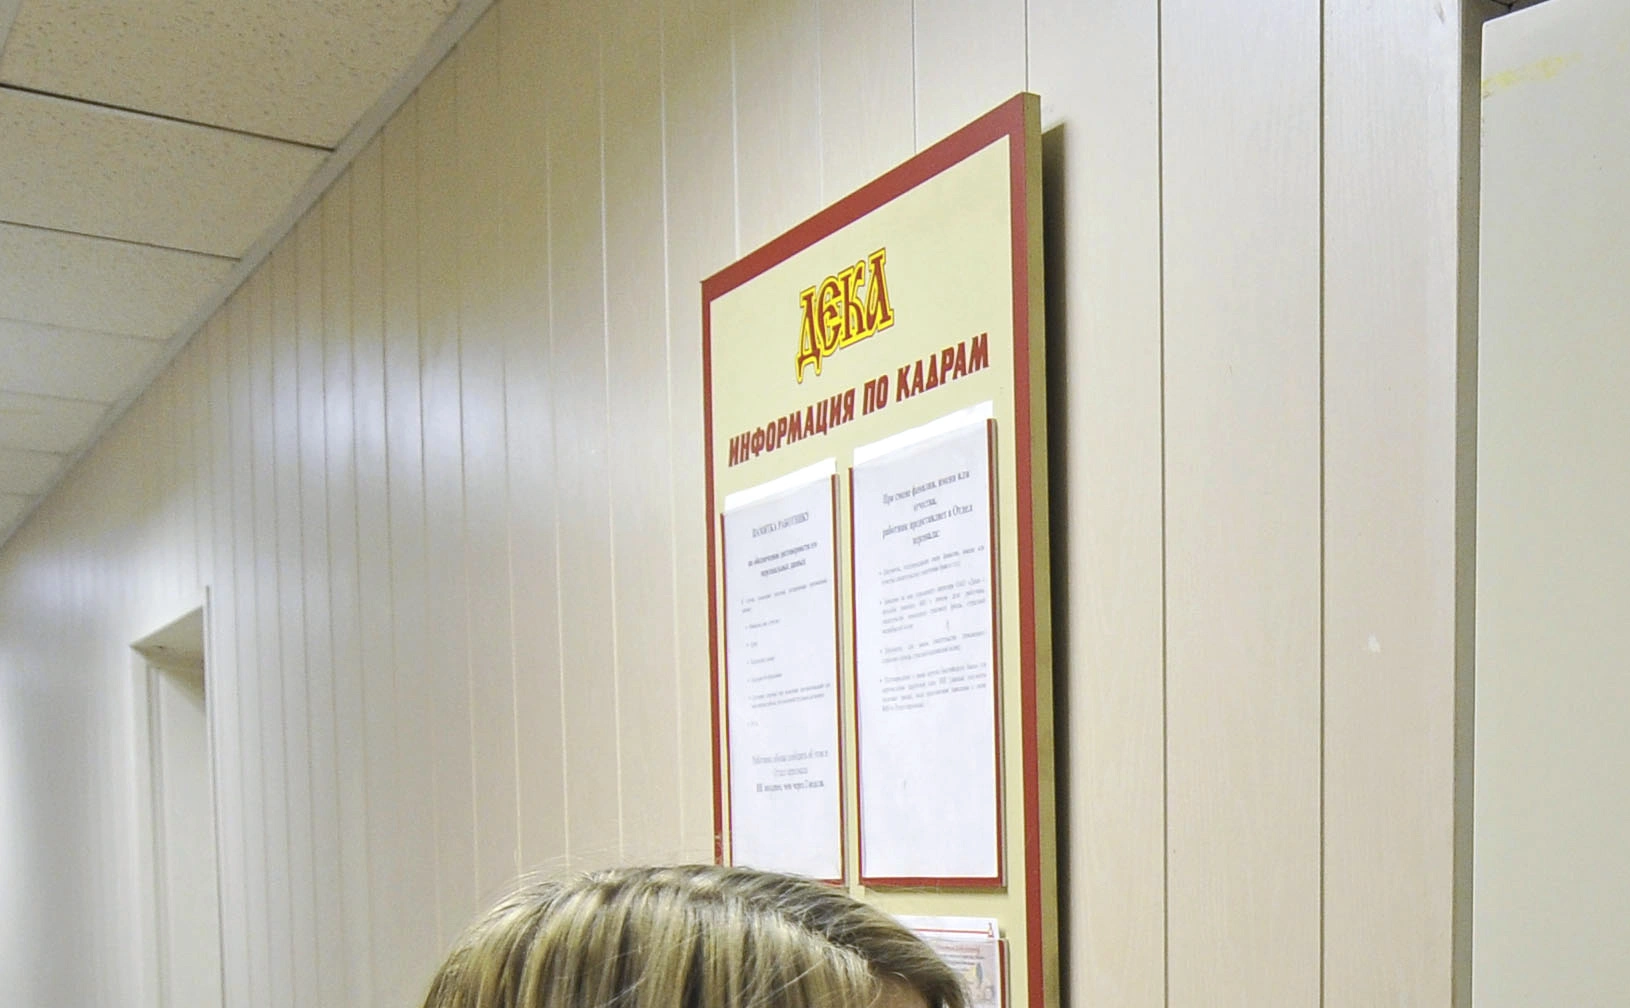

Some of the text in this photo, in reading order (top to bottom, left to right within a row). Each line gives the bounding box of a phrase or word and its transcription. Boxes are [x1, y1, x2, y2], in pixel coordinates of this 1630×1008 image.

[728, 332, 989, 467] ИНФОРМАЦИЯ ПО КАДРАМ
